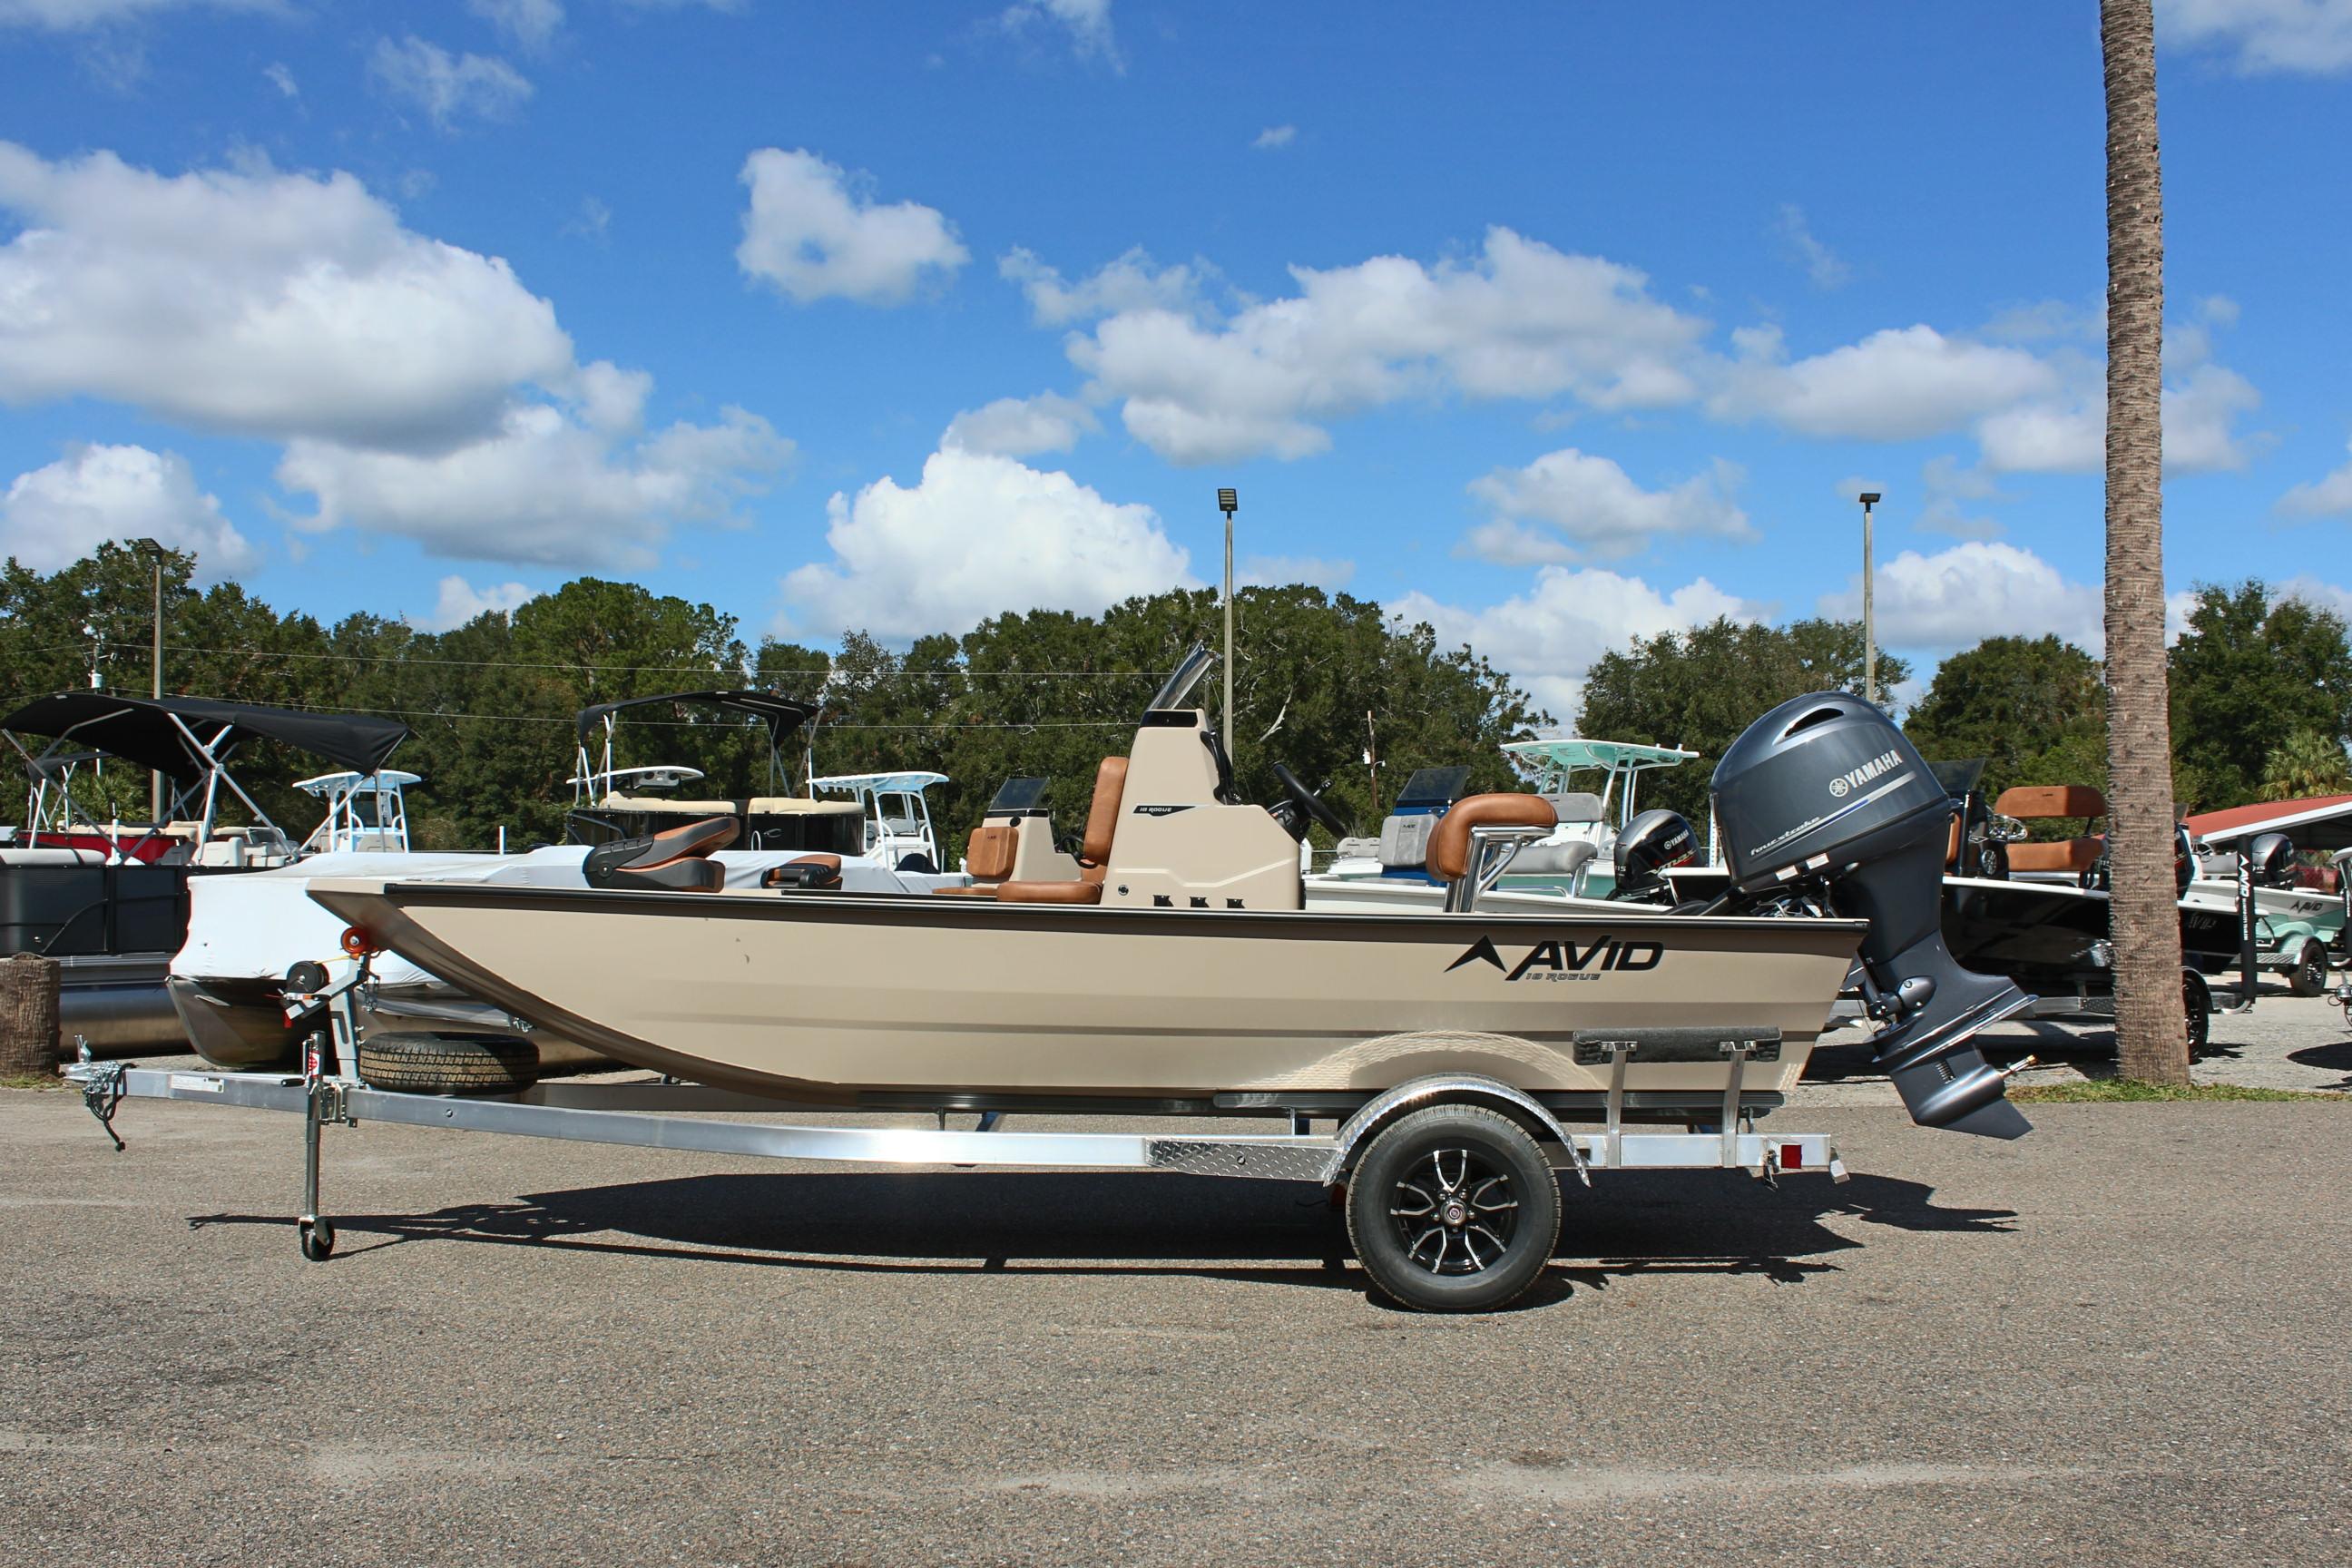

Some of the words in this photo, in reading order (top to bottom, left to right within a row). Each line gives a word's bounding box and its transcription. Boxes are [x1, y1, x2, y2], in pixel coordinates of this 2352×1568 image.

[1844, 750, 1904, 789] YAMAHA
[1504, 935, 1664, 982] AVID
[1525, 973, 1544, 981] 18
[1545, 973, 1602, 983] ROGUE
